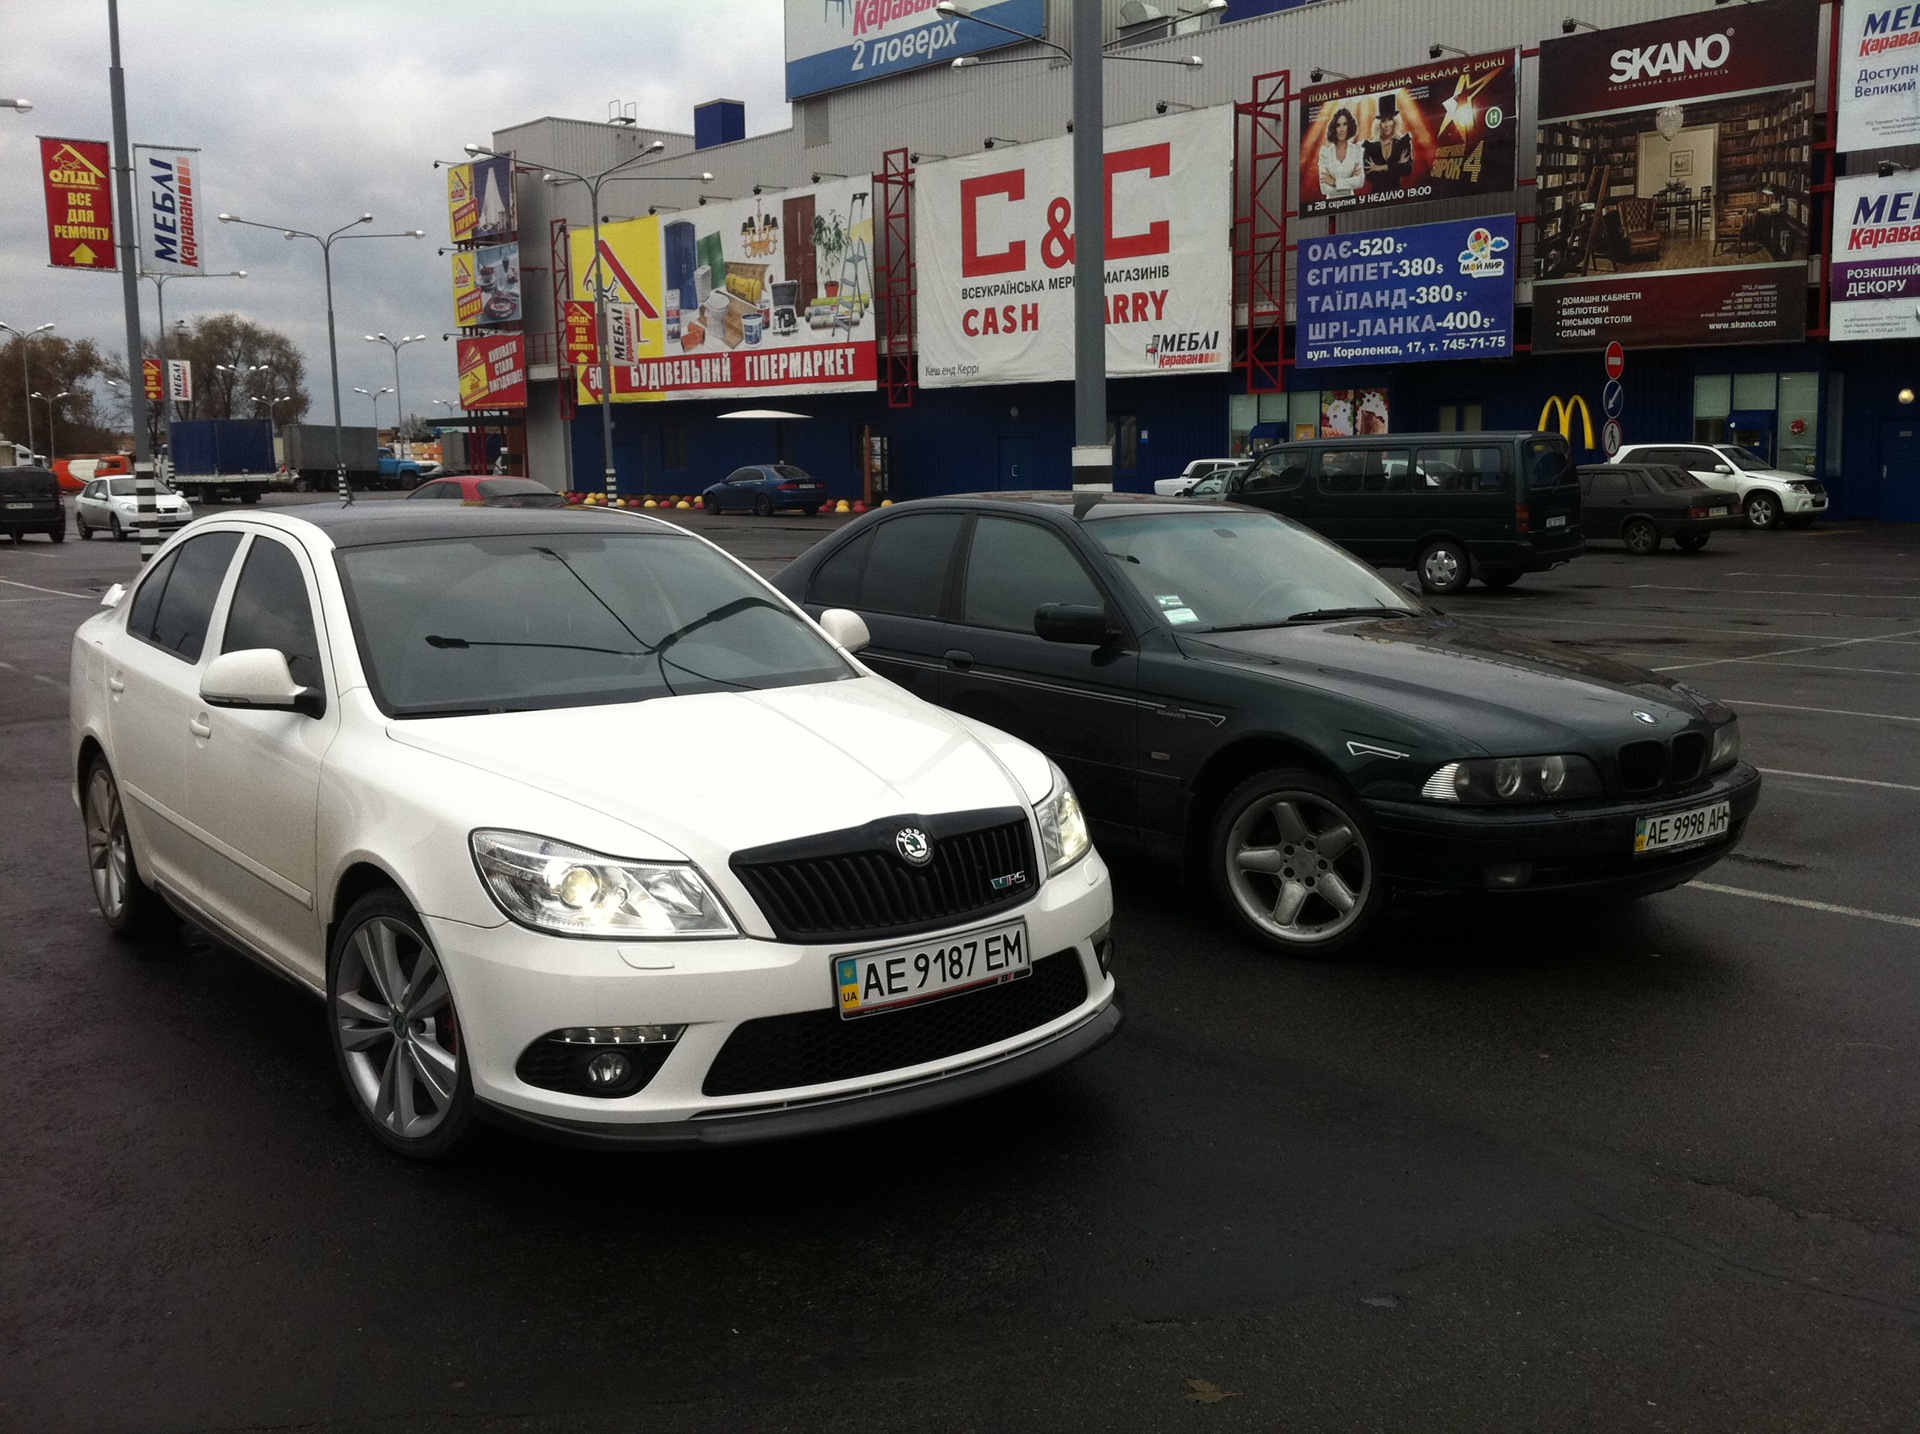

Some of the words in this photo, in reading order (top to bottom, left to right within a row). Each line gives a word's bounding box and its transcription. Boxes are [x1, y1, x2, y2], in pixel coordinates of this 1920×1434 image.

[851, 39, 865, 71] 2
[871, 20, 960, 67] поверх
[1859, 31, 1920, 57] Карава
[1608, 33, 1730, 83] SKANO
[1345, 86, 1365, 96] ЯКУ
[1416, 67, 1459, 82] ЧЕКАЛА
[1462, 64, 1470, 73] 2
[1855, 78, 1916, 98] Великий
[49, 169, 96, 184] ОЛДІ
[67, 191, 92, 206] ВСЕ
[1314, 200, 1326, 210] 28
[1328, 198, 1356, 209] серпня
[1367, 189, 1404, 203] НЕДІЛЮ
[1407, 185, 1431, 198] 19:00
[66, 208, 95, 224] ДЛЯ
[149, 157, 178, 264] МЕБЛІ
[54, 225, 109, 241] РЕМОНТУ
[178, 197, 199, 268] Караван
[1040, 197, 1075, 269] &
[1462, 260, 1482, 272] МОЙ
[1484, 260, 1502, 270] МИР
[1847, 262, 1920, 279] РОЗКІШНИЙ
[961, 277, 1045, 300] ВСЕУКРАЇНСЬКА
[1846, 279, 1907, 297] ДЕКОРУ
[1562, 293, 1600, 306] ДОМАШНІ
[1601, 291, 1641, 303] КАБІНЕТИ
[962, 302, 1039, 337] CASH
[1562, 305, 1609, 316] БІБЛІОТЕКИ
[1562, 316, 1602, 327] ПИСЬМОВІ
[1604, 315, 1632, 325] СТОЛИ
[1709, 319, 1776, 330] www.skano.com
[575, 335, 588, 343] ДЛЯ
[611, 308, 625, 361] МЕБЛІ
[1160, 331, 1219, 353] МЕБЛІ
[1561, 328, 1596, 338] СПАЛЬНІ
[1307, 349, 1331, 360] вул.
[1333, 343, 1402, 358] Короленка,
[1406, 341, 1425, 354] 17,
[1442, 335, 1505, 350] 745-71-75
[630, 353, 731, 390] БУДІВЕЛЬНИЙ
[744, 347, 855, 381] ГІПЕРМАРКЕТ
[925, 366, 940, 376] Кеш
[942, 366, 956, 376] енд
[957, 362, 979, 376] Керрі
[1158, 353, 1199, 368] Караван
[1646, 819, 1670, 846] AE
[1673, 811, 1705, 841] 9998
[1707, 805, 1727, 833] AH
[863, 957, 908, 1000] AE
[914, 941, 977, 988] 9187
[985, 930, 1022, 972] EM
[843, 991, 858, 1003] UA
